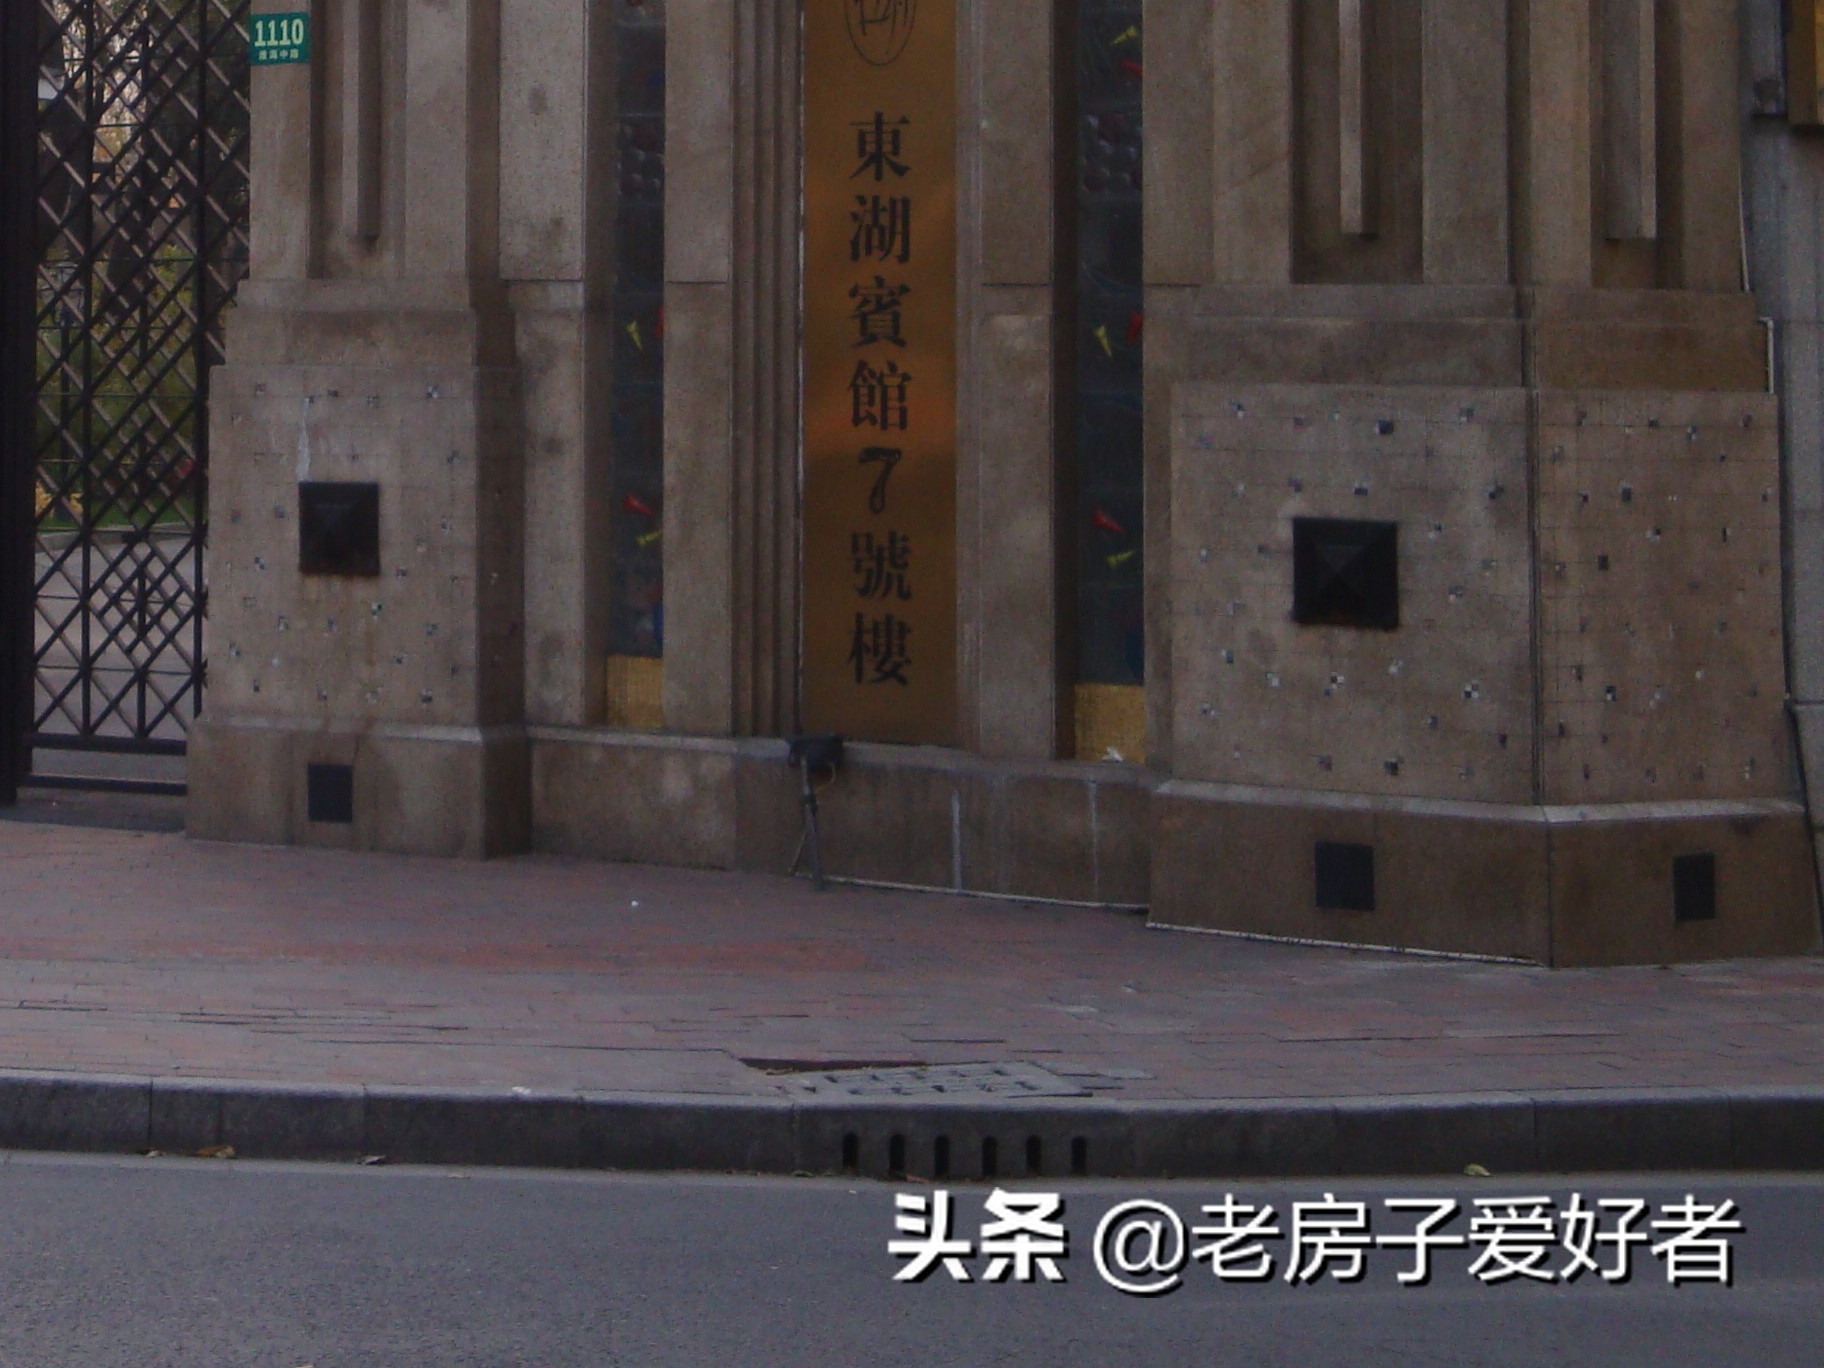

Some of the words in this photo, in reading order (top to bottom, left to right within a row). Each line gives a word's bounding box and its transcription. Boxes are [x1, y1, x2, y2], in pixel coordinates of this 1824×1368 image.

[254, 18, 304, 47] 1110
[847, 110, 914, 687] 東湖賓館7號樓
